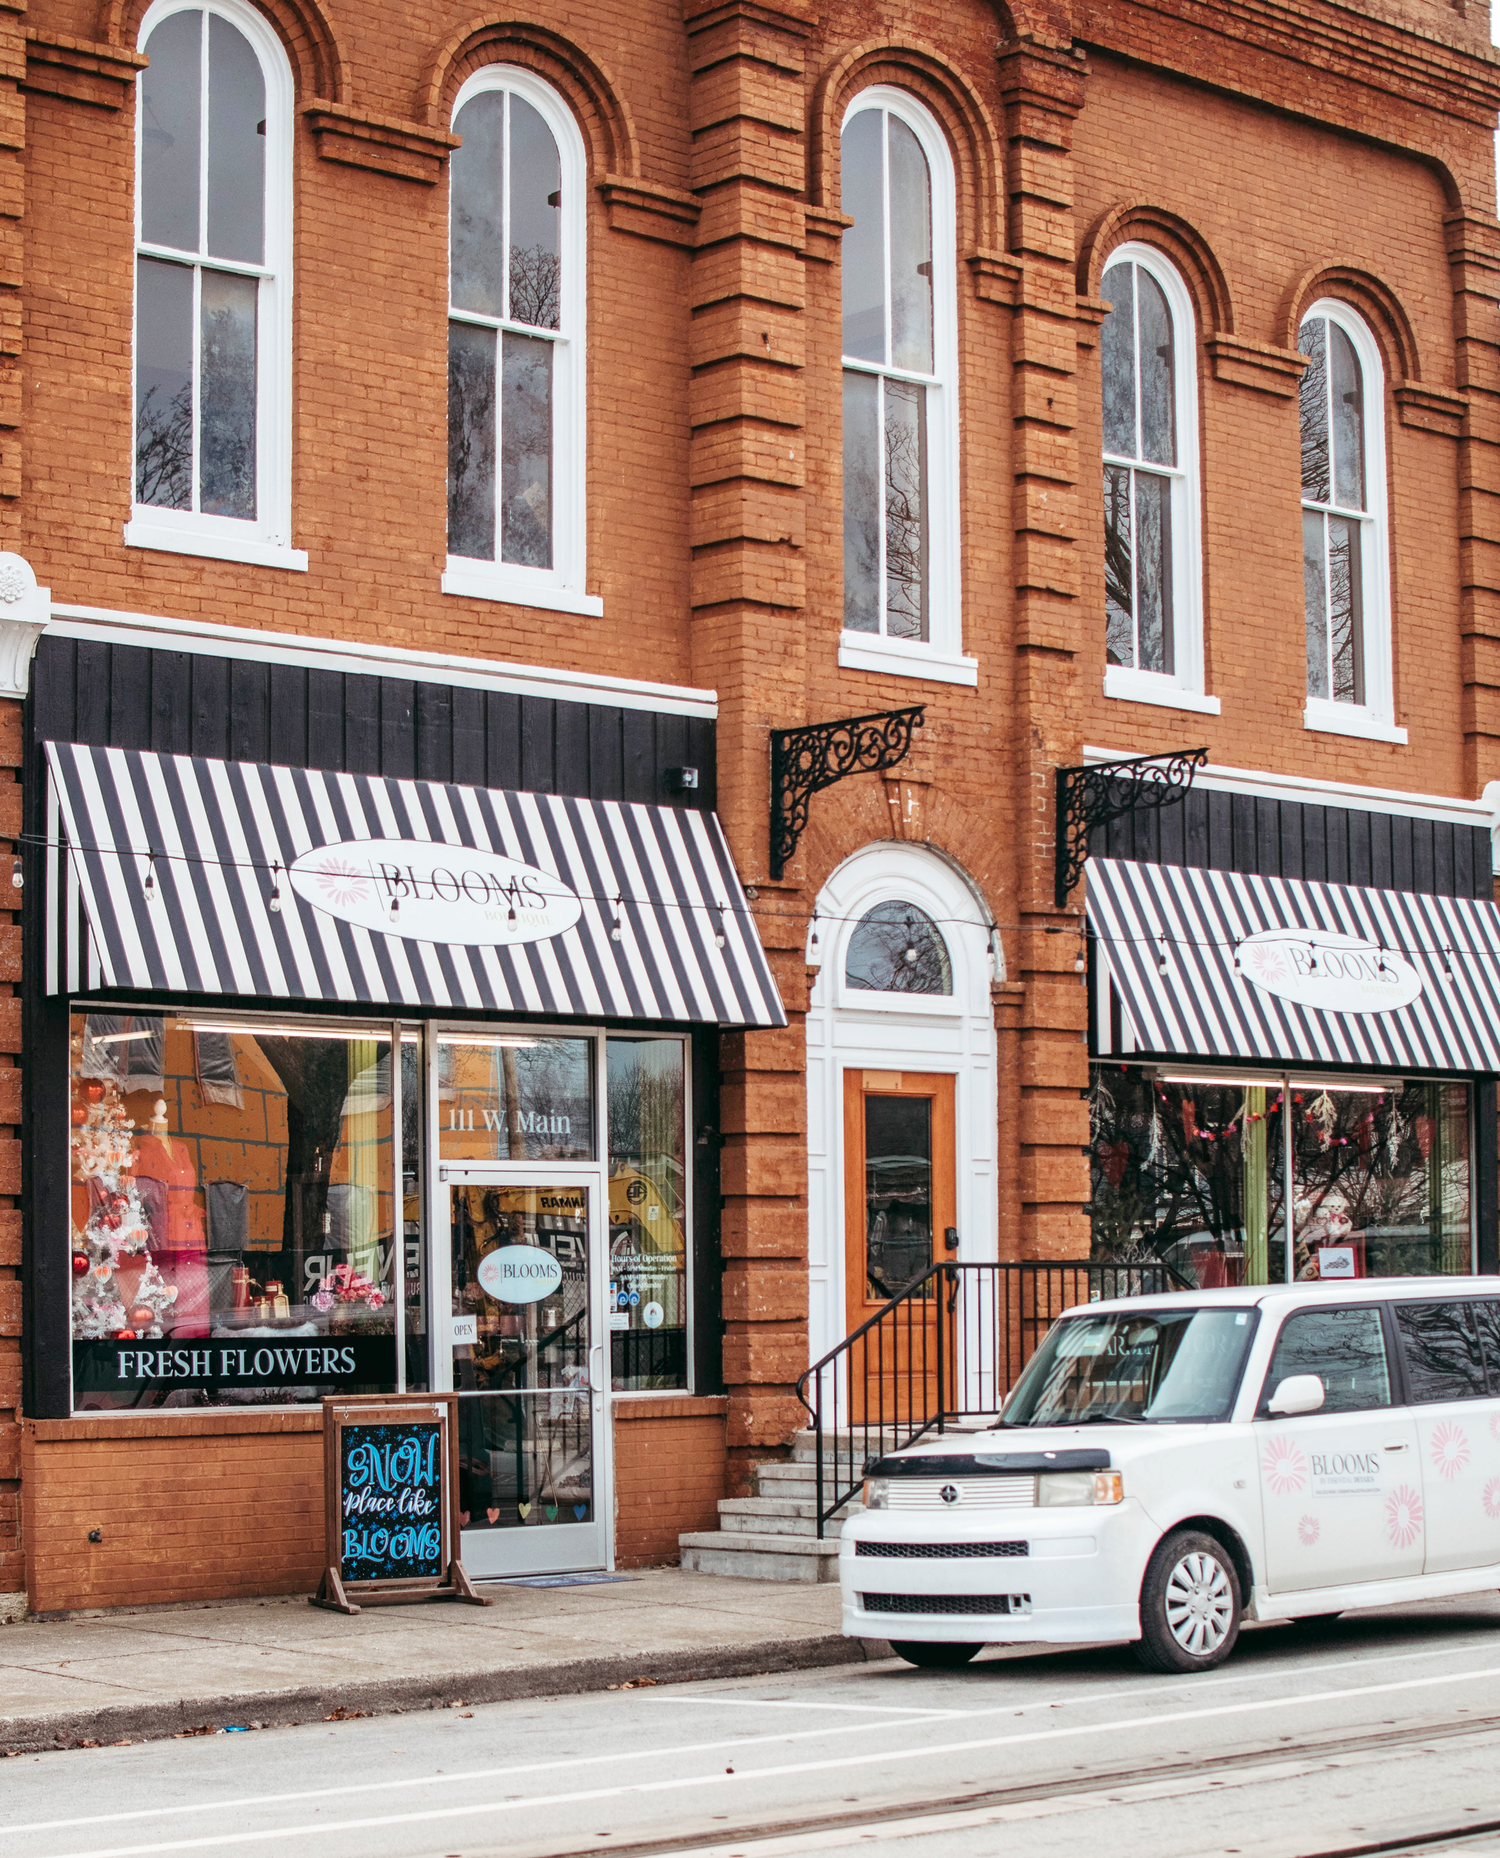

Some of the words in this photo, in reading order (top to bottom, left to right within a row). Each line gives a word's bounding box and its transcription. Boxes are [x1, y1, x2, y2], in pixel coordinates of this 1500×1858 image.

[377, 862, 547, 910] BLOOMS
[1288, 948, 1399, 984] BLOOMS
[449, 1109, 475, 1131] 111
[481, 1109, 509, 1132] W.
[515, 1109, 571, 1134] Main
[503, 1264, 558, 1279] BLOOMS
[611, 1254, 632, 1262] Hours
[633, 1254, 641, 1262] of
[643, 1255, 677, 1264] Operation
[454, 1324, 473, 1336] OPEN
[117, 1350, 212, 1378] FRESH
[220, 1347, 356, 1376] FLOWERS
[347, 1432, 439, 1491] SNOW
[1311, 1453, 1380, 1475] BLOOMS
[343, 1485, 396, 1516] place
[397, 1487, 436, 1515] like
[341, 1522, 440, 1563] BLOOMS
